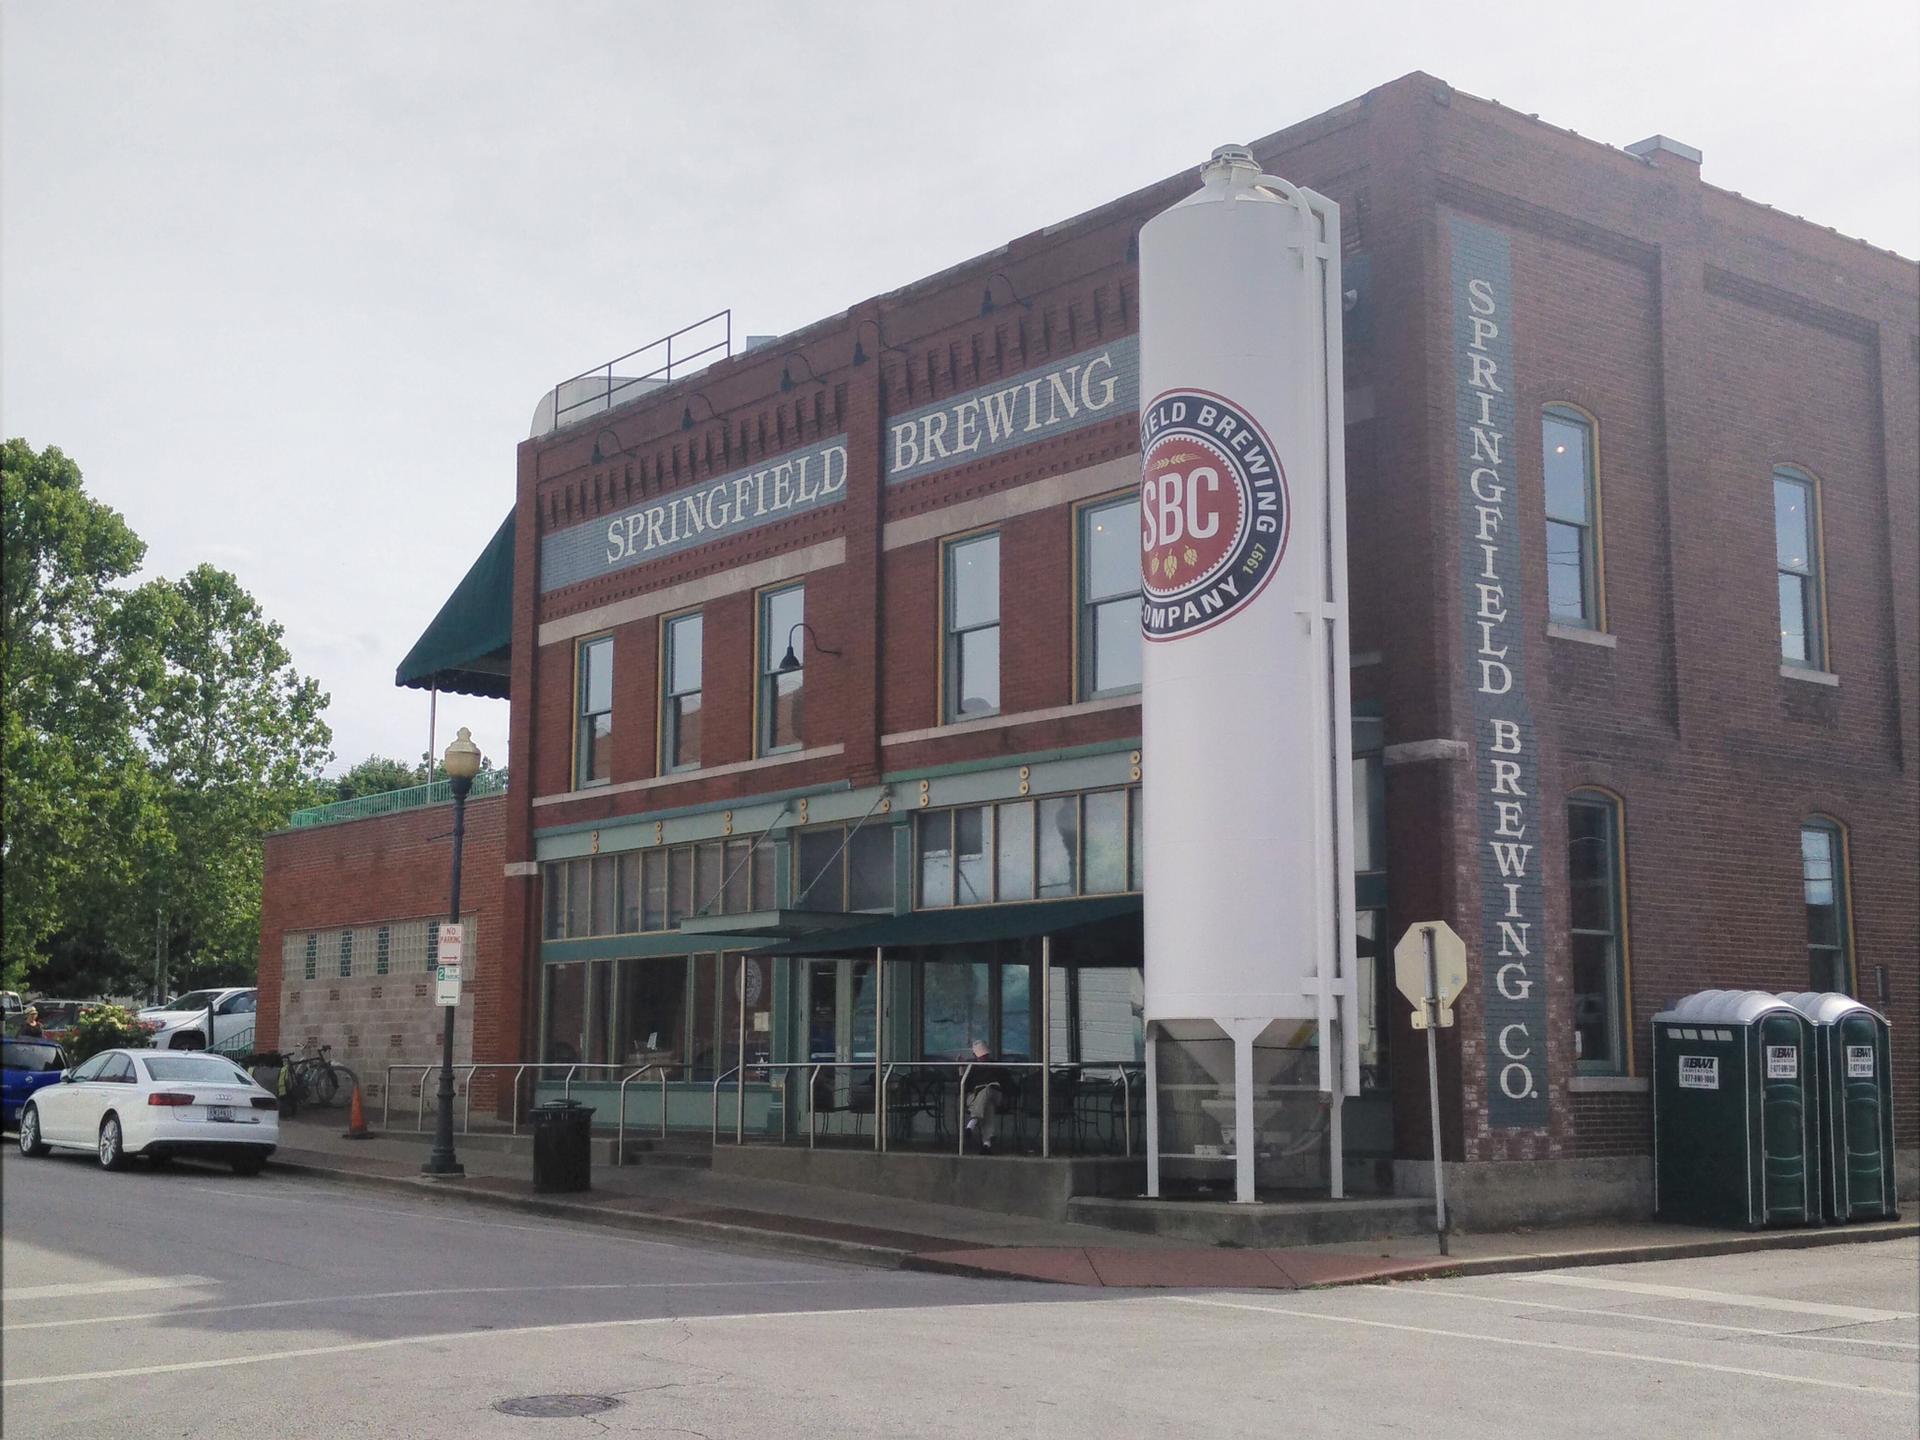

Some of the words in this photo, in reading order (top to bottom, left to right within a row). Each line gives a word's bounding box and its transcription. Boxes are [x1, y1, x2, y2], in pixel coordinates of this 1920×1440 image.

[606, 446, 848, 564] SPRINGFIELD
[890, 352, 1119, 473] BREWING
[1197, 405, 1277, 534] BREWING
[1143, 467, 1219, 552] SBC
[1468, 279, 1512, 694] SPRINGFIELD
[1243, 543, 1267, 575] 1997
[1142, 575, 1239, 628] OMPANY
[1489, 719, 1533, 1000] BREWING
[440, 936, 461, 944] PARKING
[447, 927, 456, 935] NO
[438, 969, 445, 979] 2
[1499, 1023, 1538, 1099] CO.
[1689, 1058, 1715, 1068] BWI
[1777, 1048, 1794, 1058] BWI
